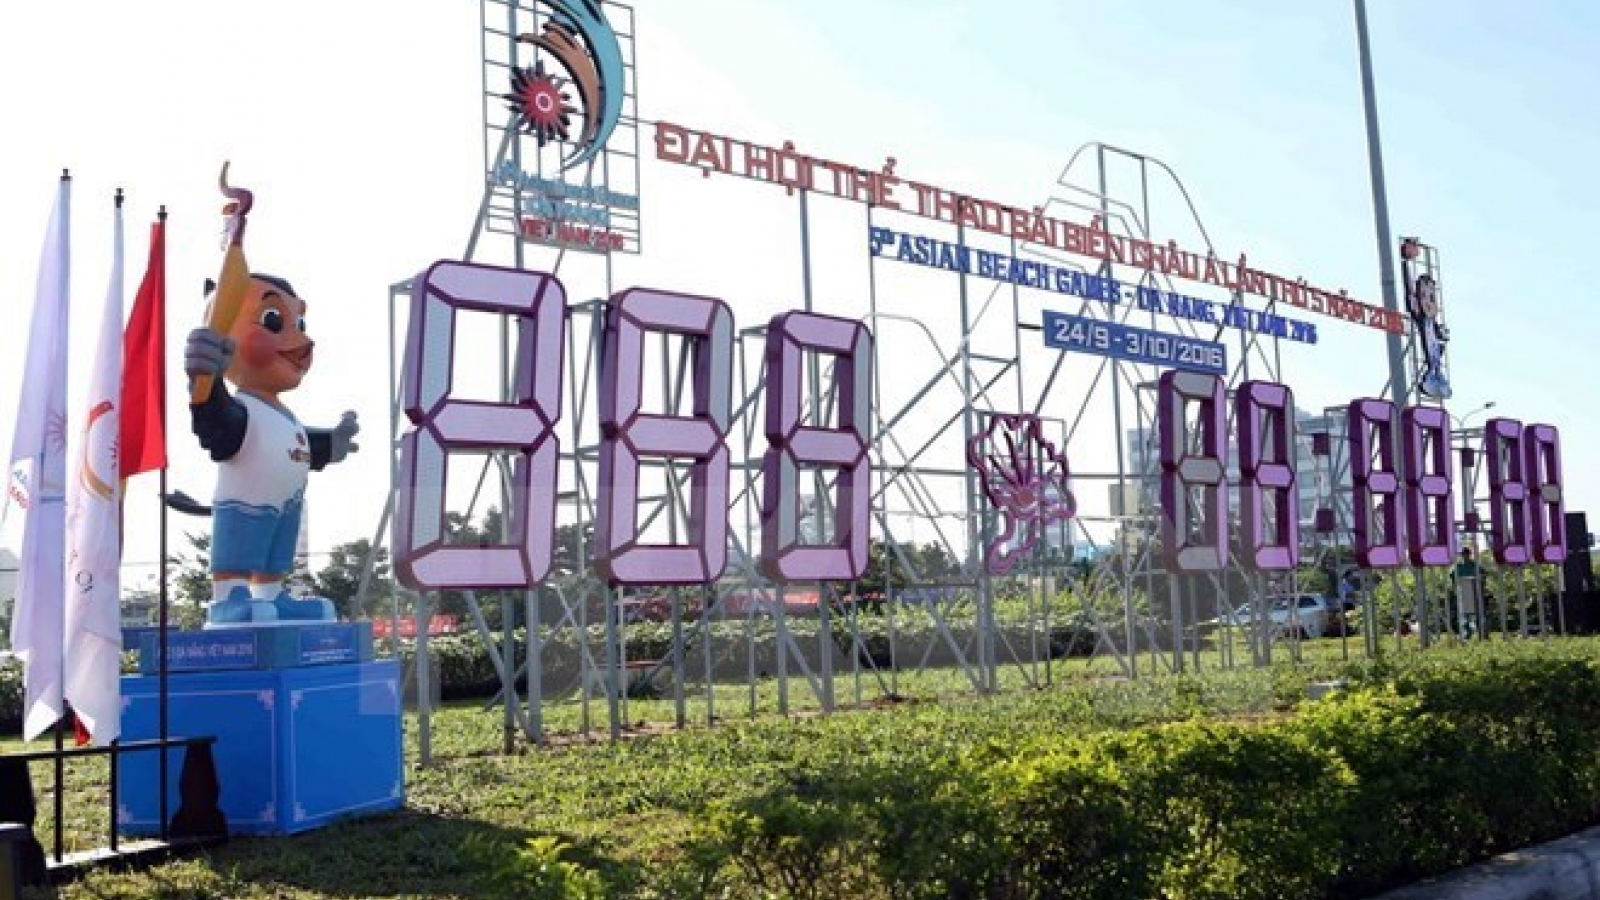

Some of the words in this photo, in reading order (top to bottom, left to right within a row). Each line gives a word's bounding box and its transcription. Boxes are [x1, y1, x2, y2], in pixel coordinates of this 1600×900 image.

[654, 120, 733, 179] ĐẠI
[744, 139, 813, 197] HỘI
[908, 181, 1003, 236] THAO
[896, 232, 961, 275] ASIAN
[977, 248, 1050, 292] BEACH
[1053, 318, 1110, 350] 24/9
[1125, 332, 1224, 370] 3/10/2016
